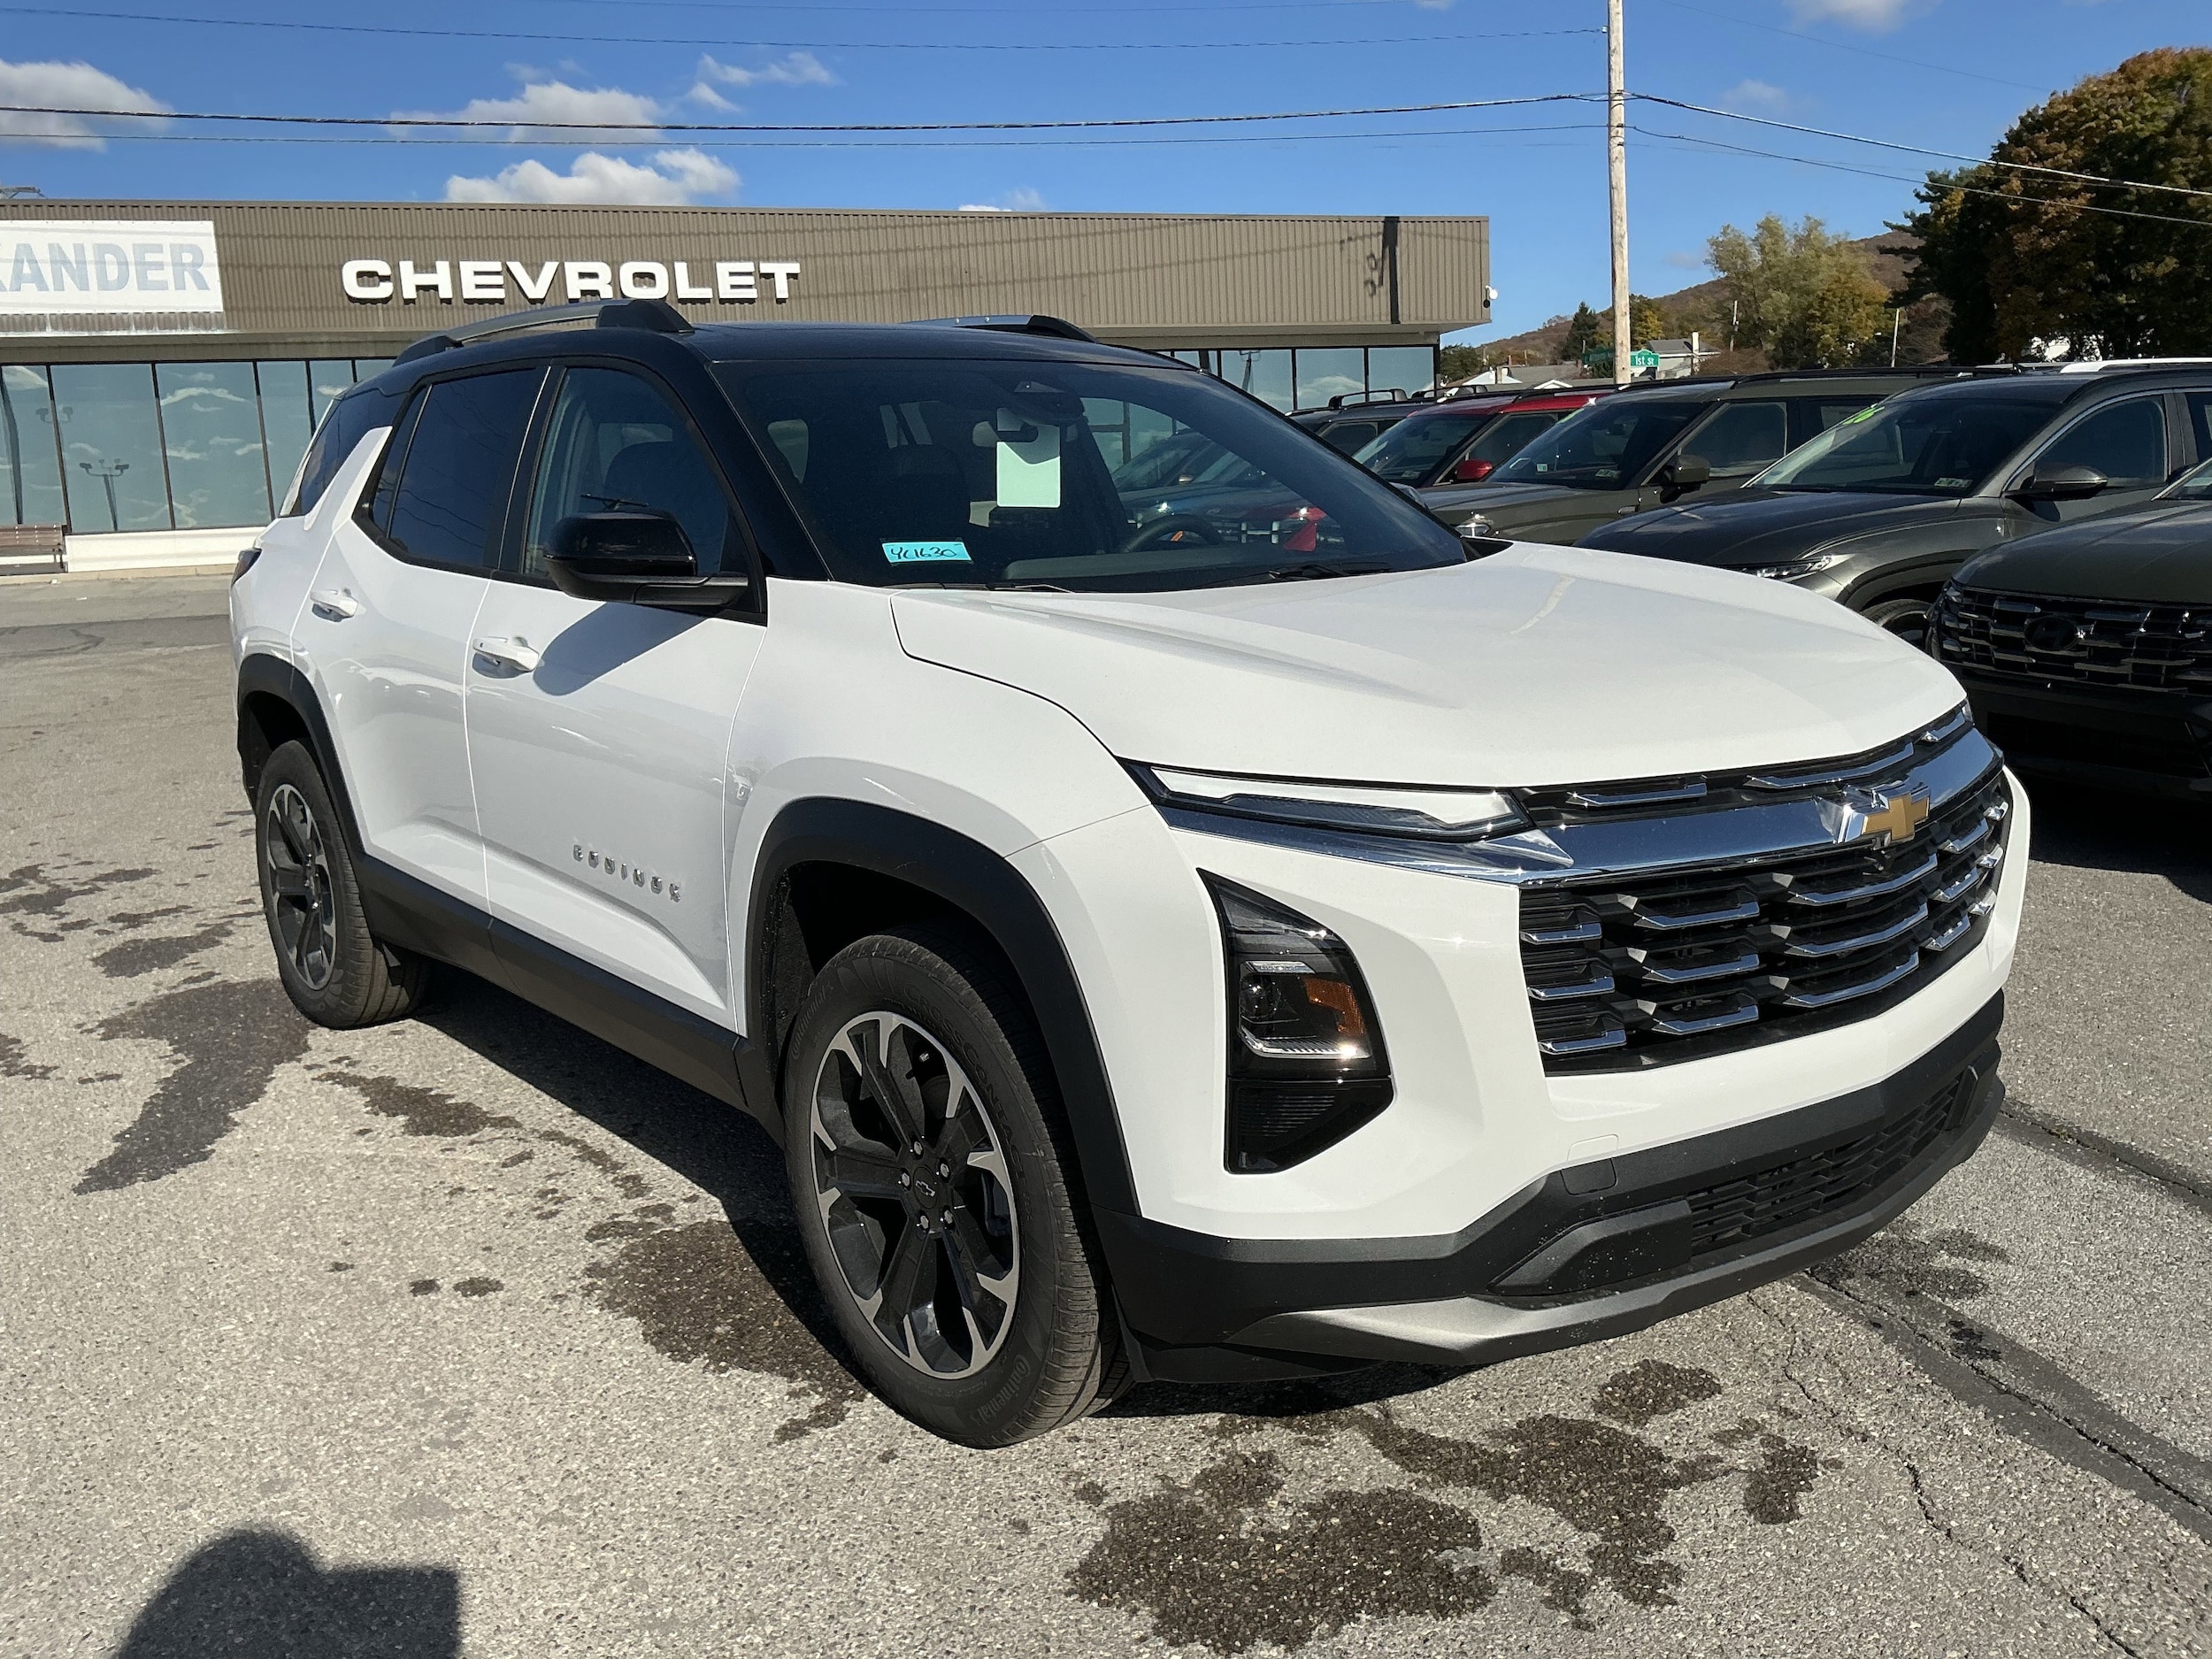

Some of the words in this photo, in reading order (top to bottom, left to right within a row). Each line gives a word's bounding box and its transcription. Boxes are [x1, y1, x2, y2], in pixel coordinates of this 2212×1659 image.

[0, 242, 211, 292] ANDER
[342, 258, 802, 302] CHEVROLET
[1635, 356, 1645, 365] 1st
[977, 1353, 1032, 1425] Continental
